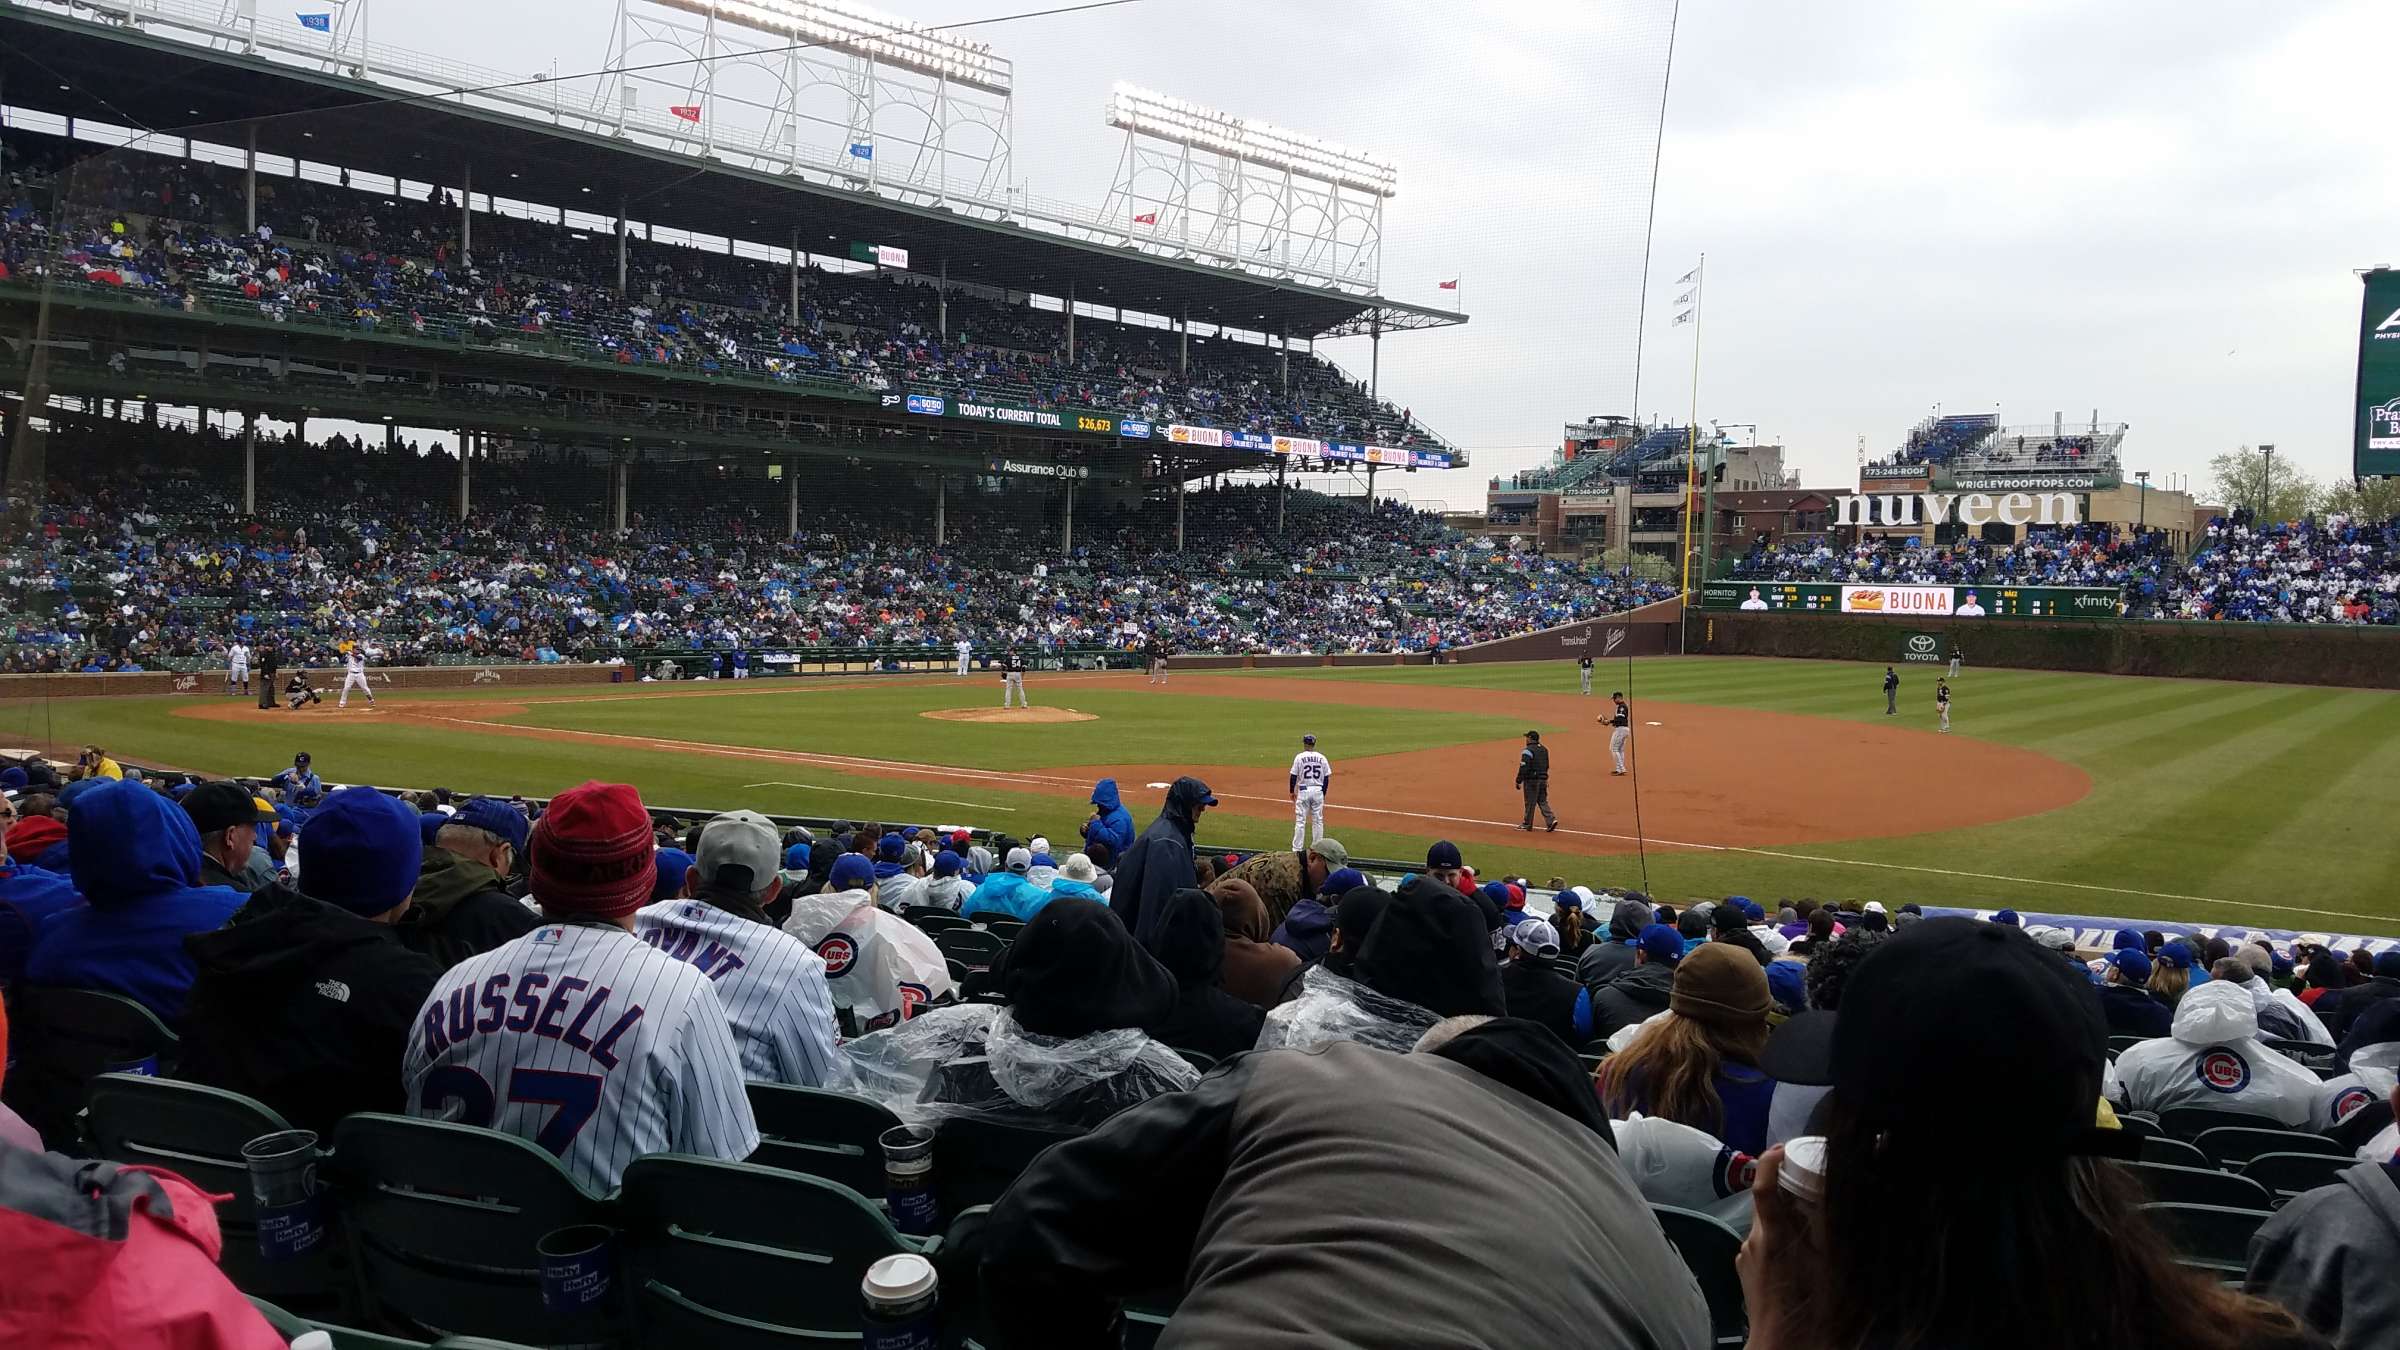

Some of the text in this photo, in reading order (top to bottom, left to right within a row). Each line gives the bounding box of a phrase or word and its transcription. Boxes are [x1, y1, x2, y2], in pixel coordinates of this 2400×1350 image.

[881, 250, 906, 263] BUONA
[958, 402, 1062, 426] TODAY'S CURRENT TOTAL
[1078, 416, 1111, 432] $26,673
[2389, 421, 2400, 434] B
[1191, 430, 1220, 445] BUONA
[1292, 441, 1318, 455] BUONA
[1383, 450, 1407, 463] BUONA
[1003, 460, 1077, 478] Assurance Club
[1864, 466, 1926, 476] 773-248-ROOF
[1956, 478, 2094, 490] WRIGLEYROOFTOPS.COM
[1834, 491, 2084, 527] nuveen
[1703, 588, 1737, 597] HORNITOS
[1890, 591, 1947, 610] BUONA
[2073, 594, 2117, 610] xfinity
[1560, 635, 1588, 647] TransUnion
[1011, 659, 1022, 668] 54
[1904, 652, 1940, 661] TOYOTA
[1303, 764, 1322, 780] 25
[633, 927, 745, 982] RYANT
[423, 972, 643, 1071] RUSSELL
[2205, 1054, 2242, 1087] CUBS
[277, 1223, 308, 1241] Hefty
[548, 1265, 579, 1278] Hefty
[564, 1272, 597, 1291] Hefty
